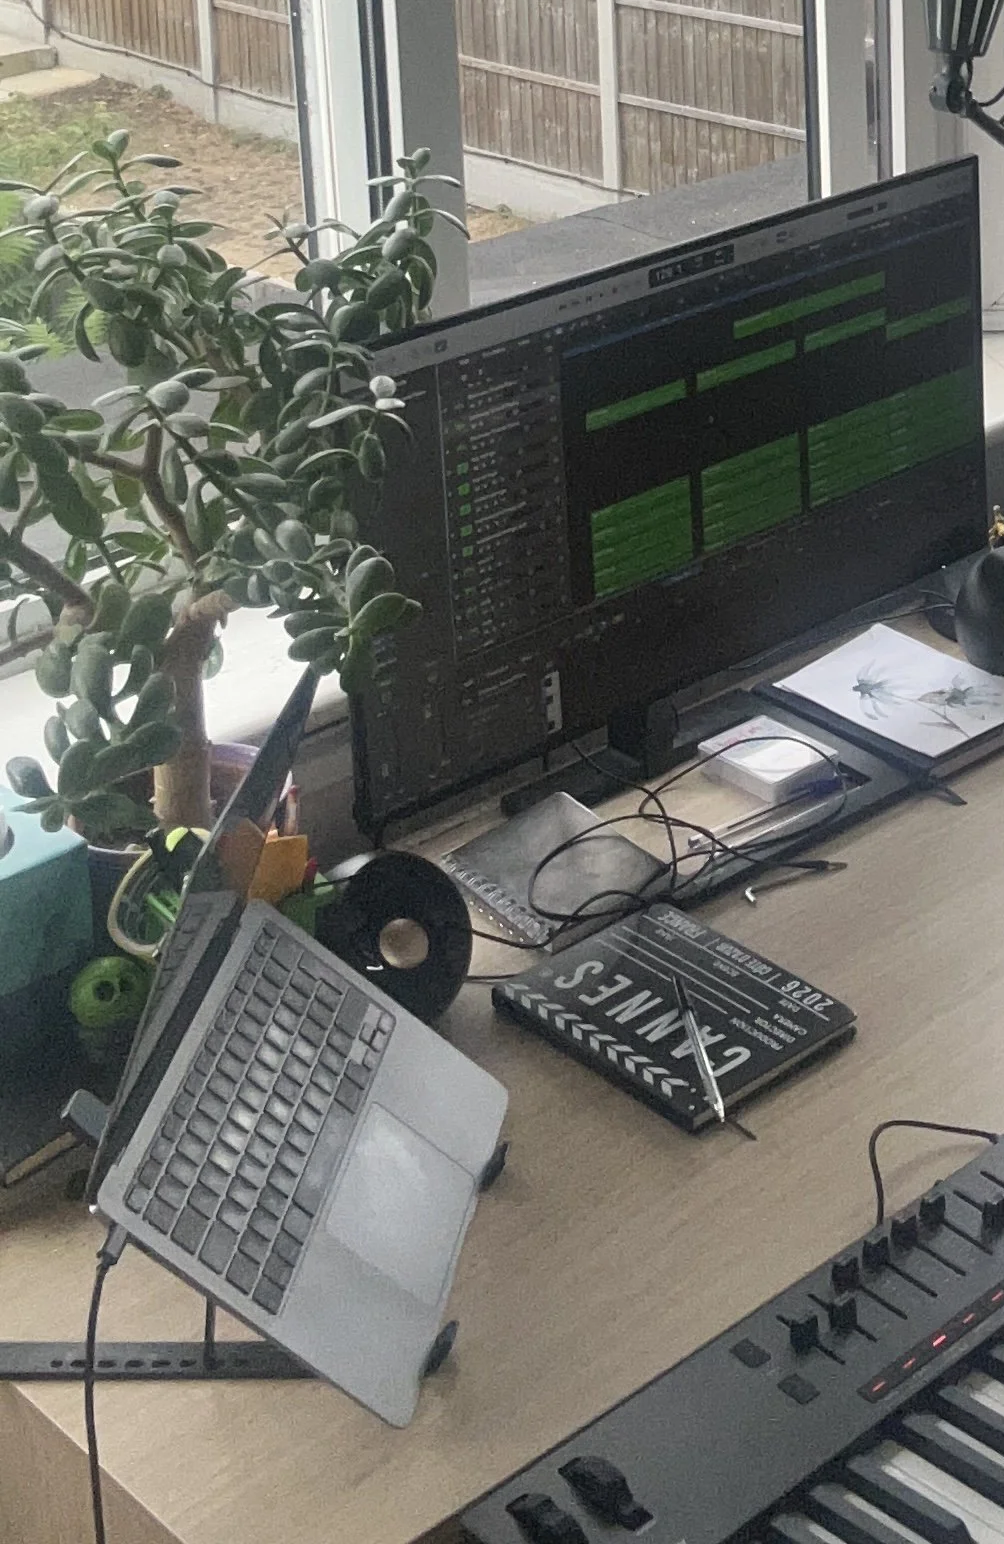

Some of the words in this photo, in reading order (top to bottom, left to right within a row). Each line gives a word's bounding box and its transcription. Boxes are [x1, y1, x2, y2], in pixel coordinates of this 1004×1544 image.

[781, 980, 834, 1011] 2026
[554, 960, 751, 1077] CANNES
[729, 1017, 784, 1051] PRODUCTION
[755, 1016, 796, 1044] DIRECTOR
[773, 1013, 807, 1036] CAMERA
